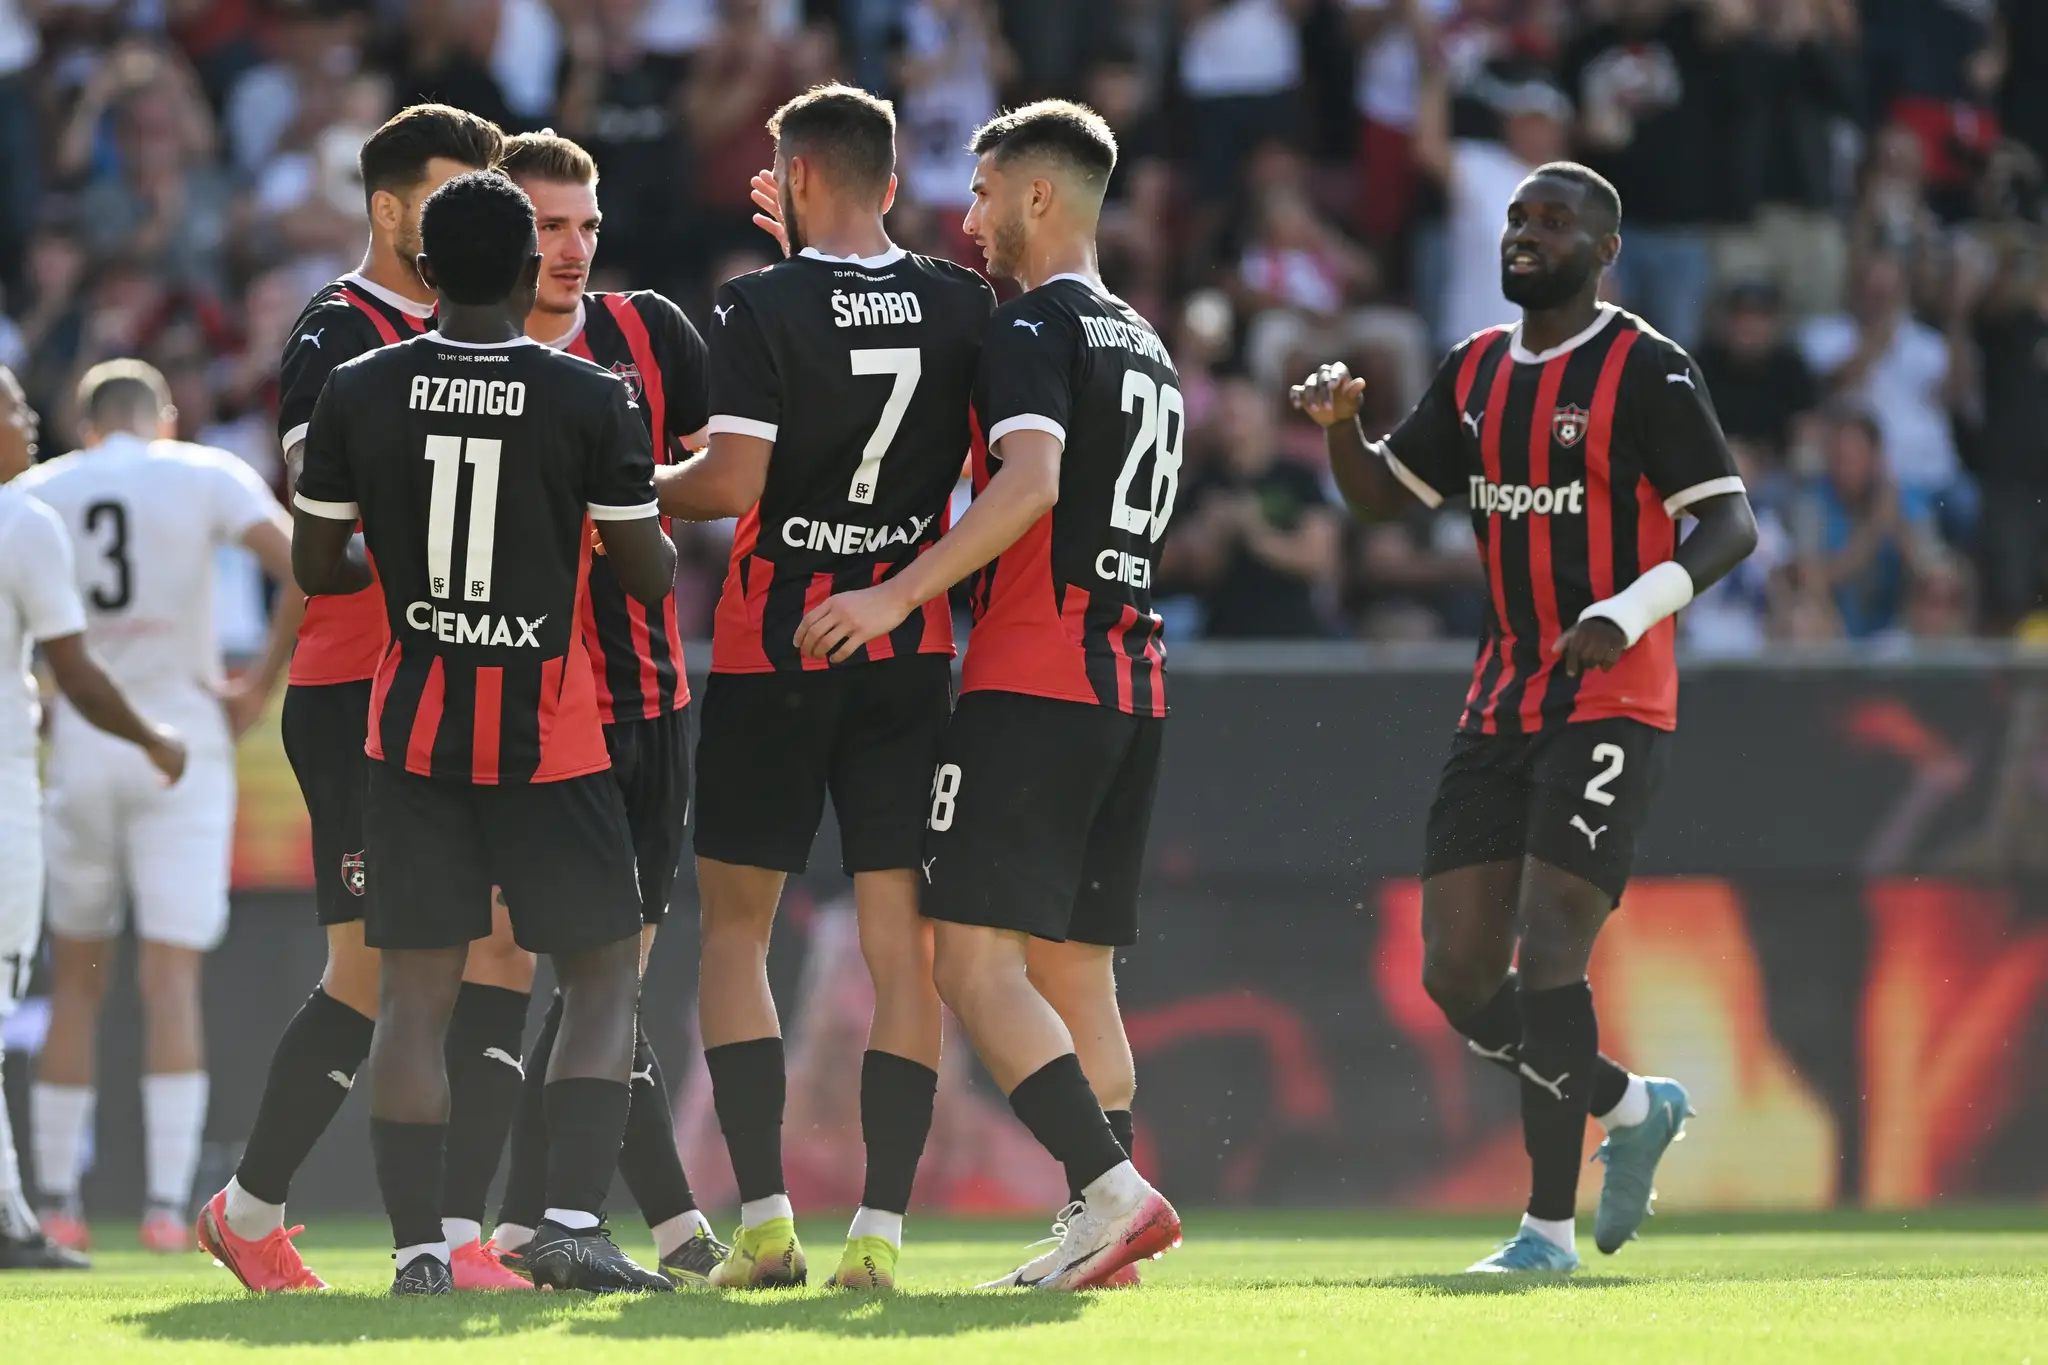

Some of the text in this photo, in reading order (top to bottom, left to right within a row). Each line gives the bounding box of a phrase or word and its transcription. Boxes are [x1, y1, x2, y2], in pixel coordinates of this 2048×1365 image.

[833, 270, 844, 278] TO
[437, 353, 446, 361] TO
[458, 354, 473, 363] SME
[474, 355, 510, 363] SPARTAK
[409, 375, 526, 417] AZANGO
[848, 347, 922, 505] 7
[1110, 368, 1185, 544] 28
[424, 434, 503, 603] 11
[1469, 475, 1585, 521] Tipsport
[86, 499, 131, 612] 3
[927, 763, 962, 832] 8
[1584, 742, 1625, 806] 2
